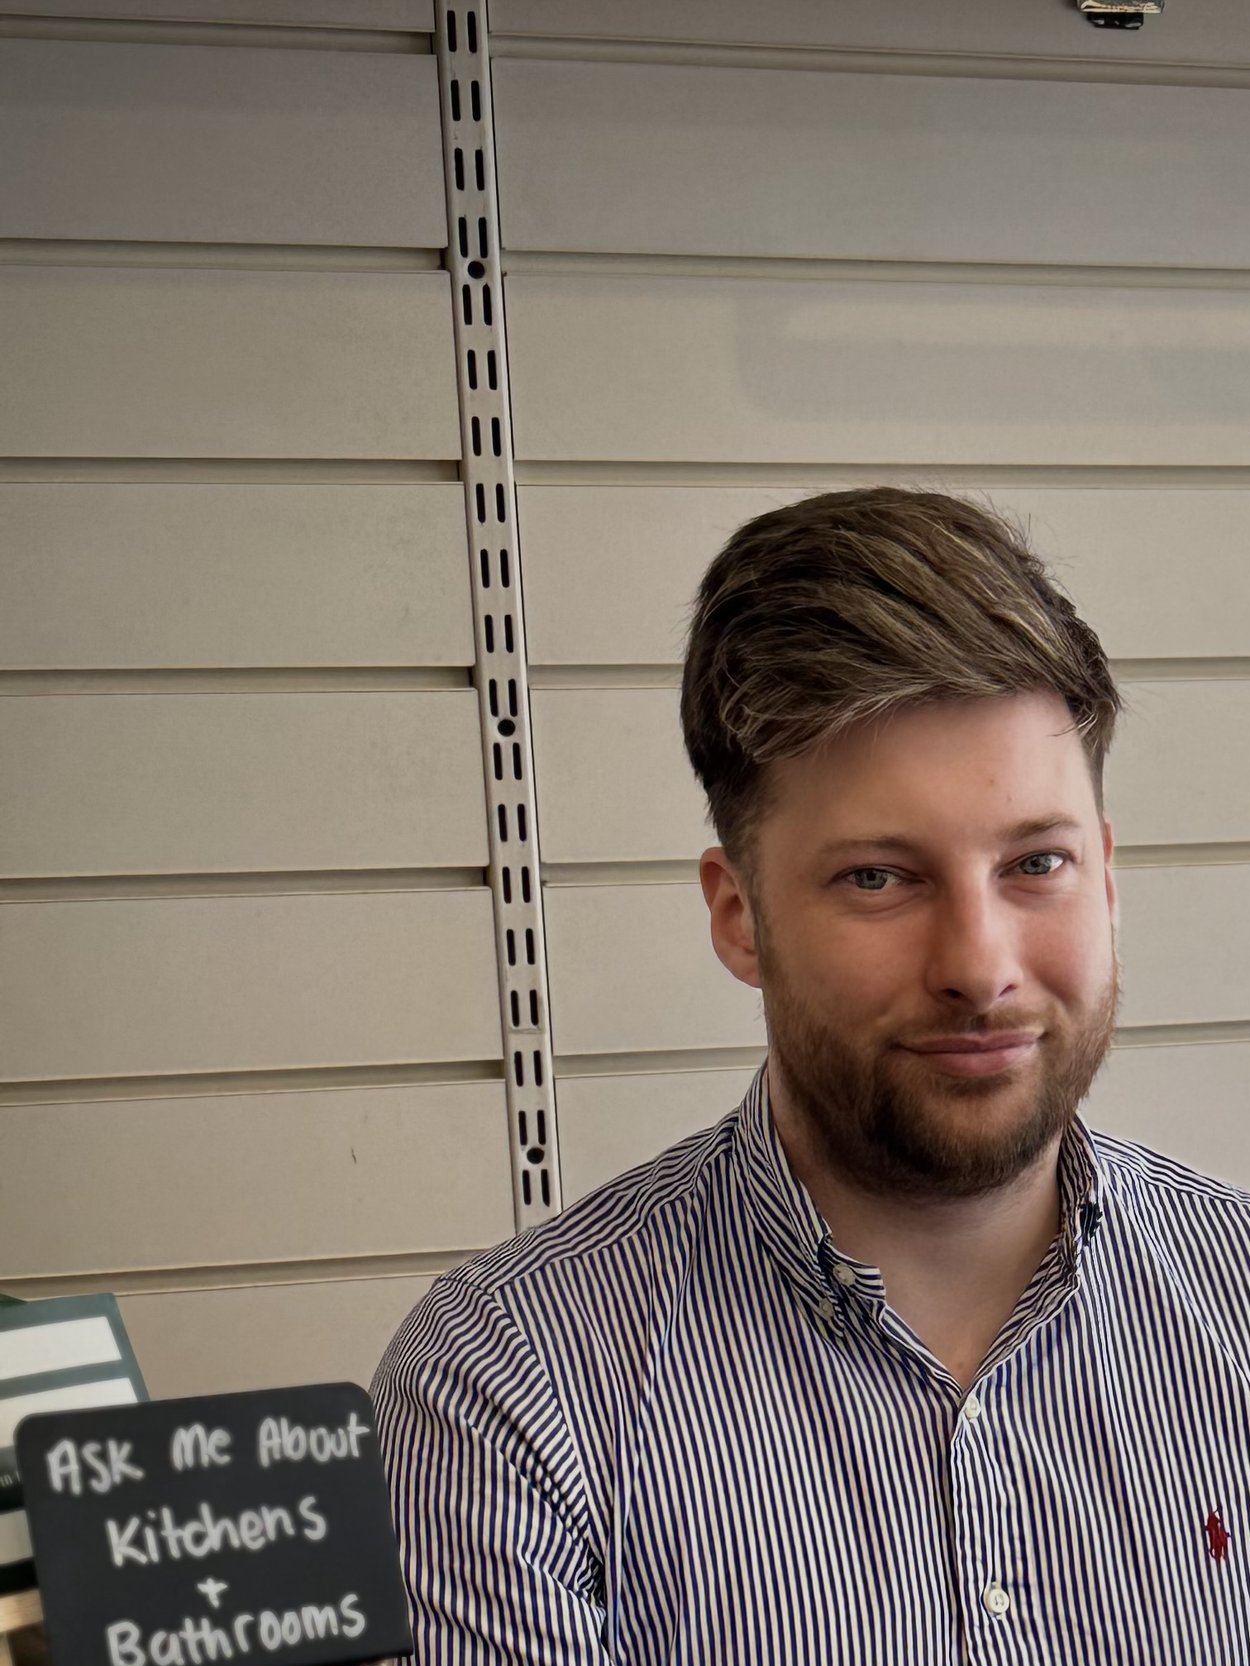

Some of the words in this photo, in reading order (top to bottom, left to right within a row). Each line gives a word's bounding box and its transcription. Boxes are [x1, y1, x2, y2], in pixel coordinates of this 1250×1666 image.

[258, 1412, 371, 1468] About
[105, 1495, 328, 1567] Kitchens
[197, 1577, 229, 1608] +
